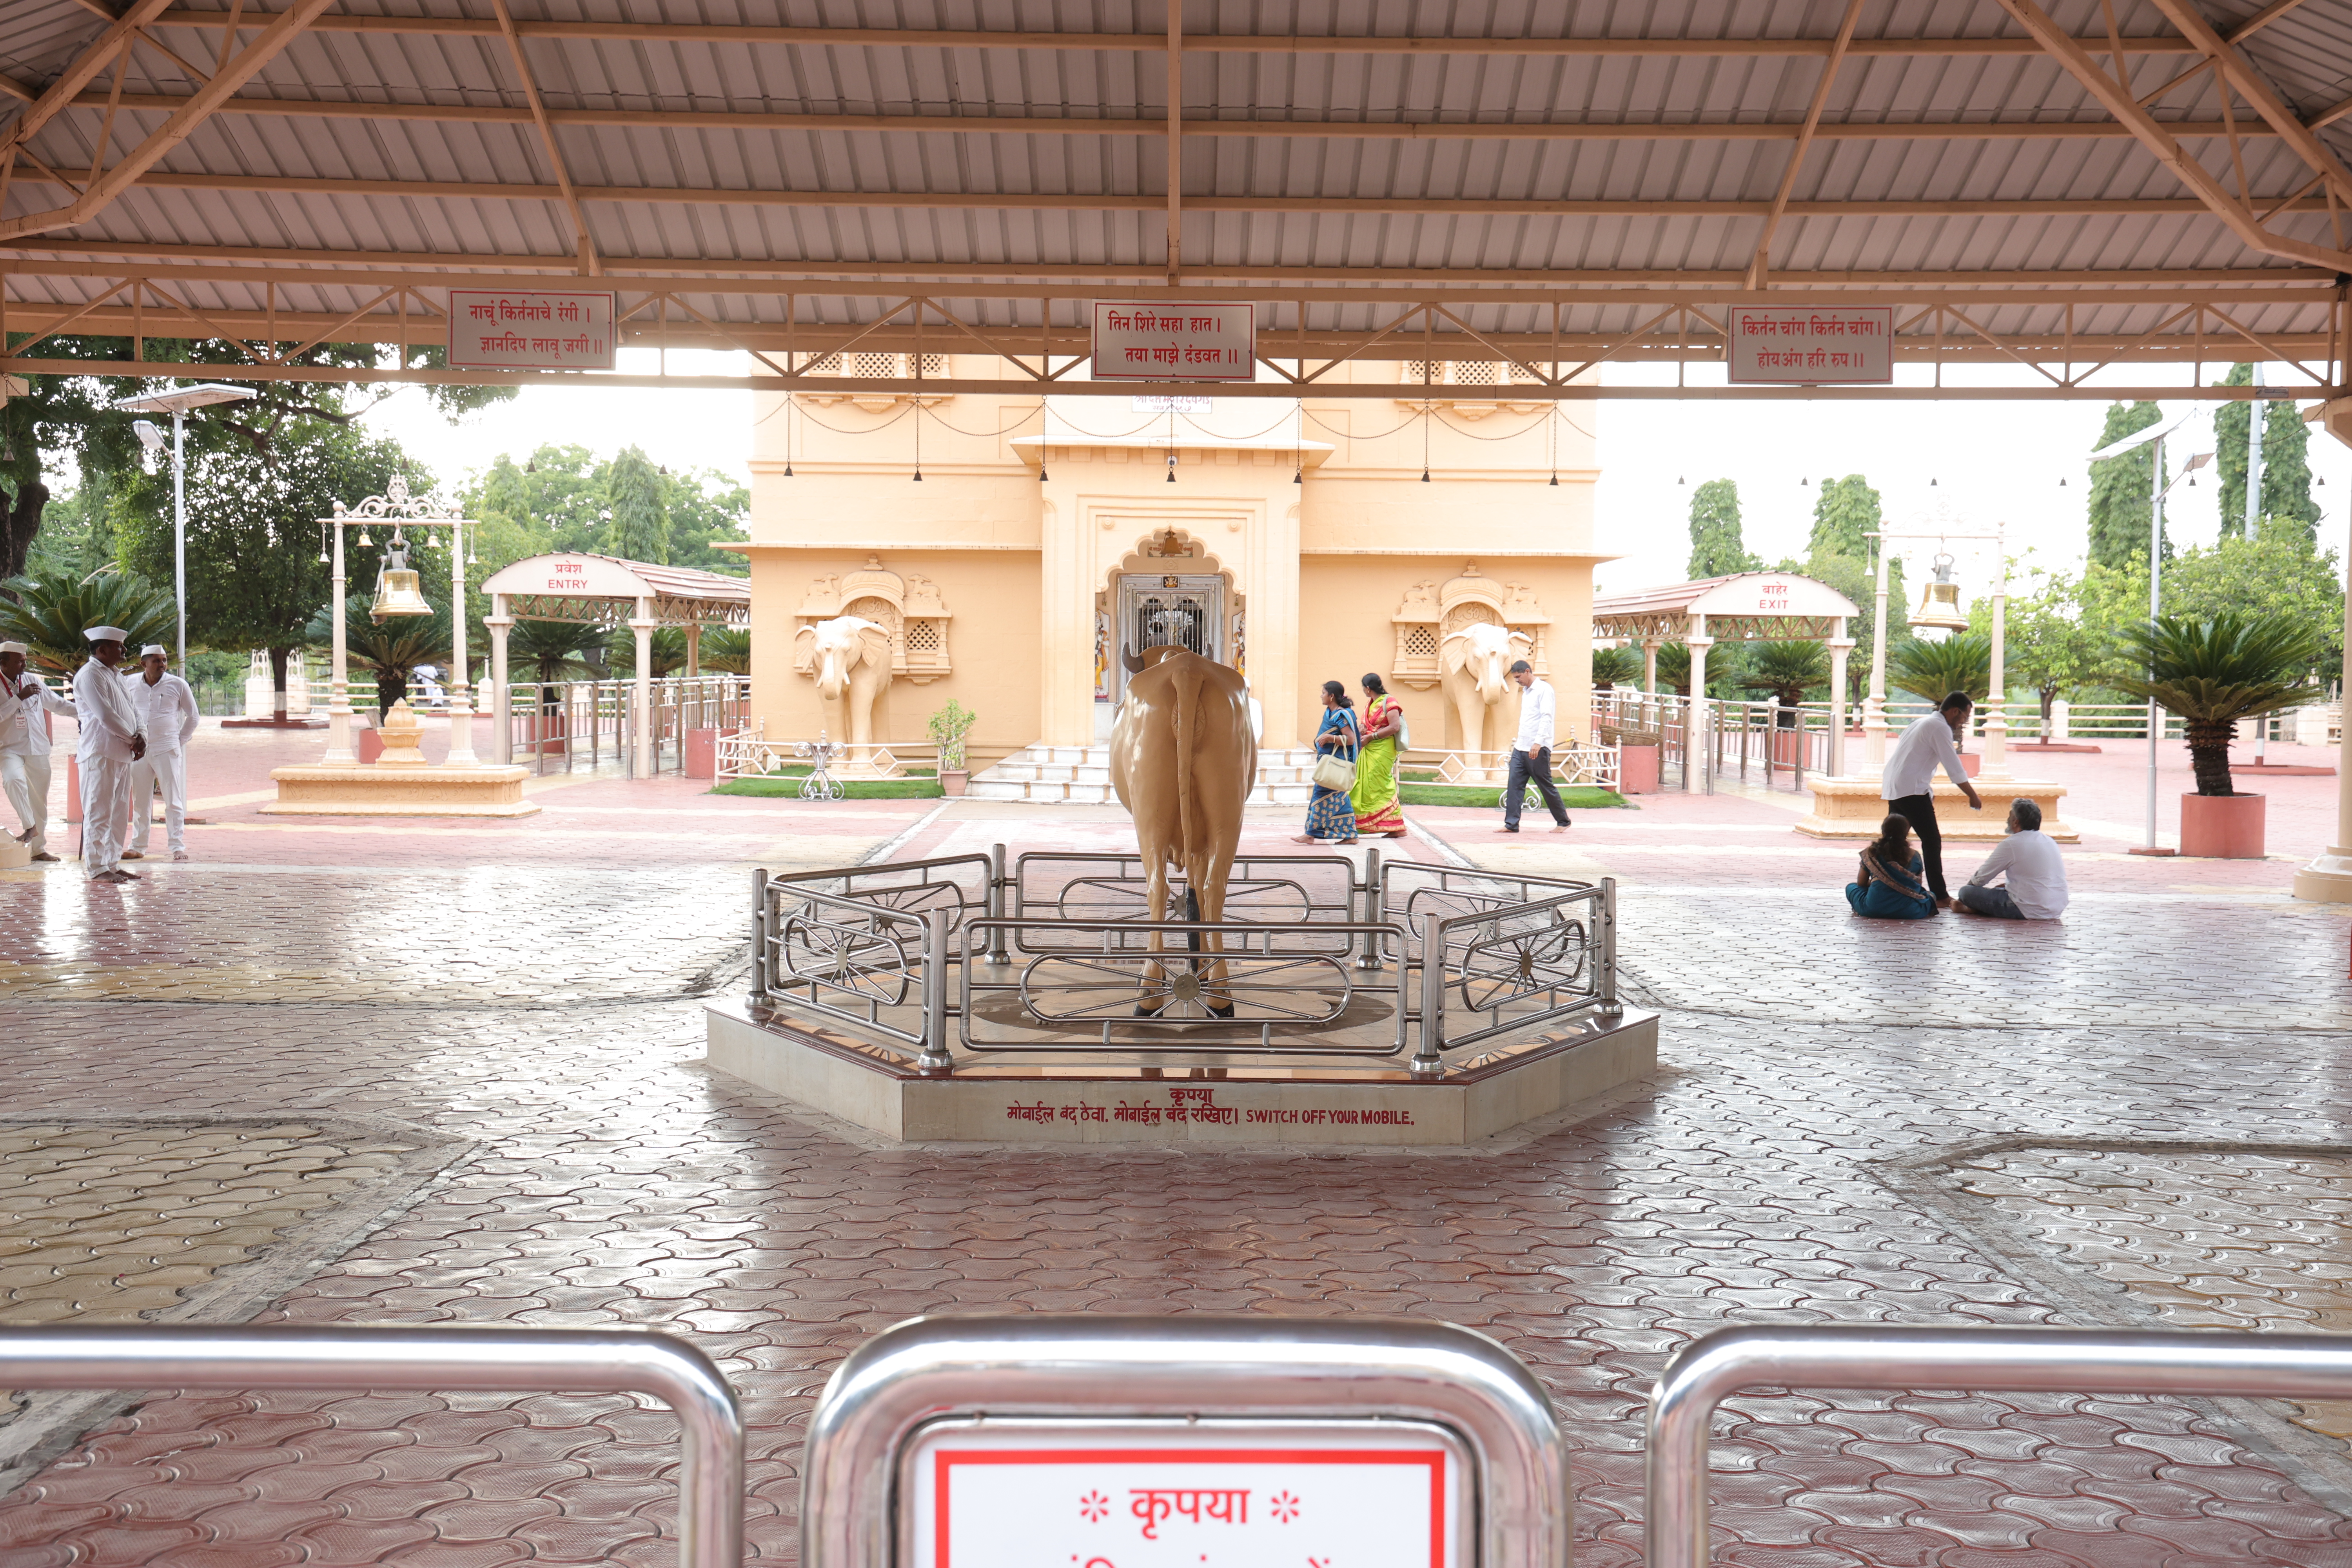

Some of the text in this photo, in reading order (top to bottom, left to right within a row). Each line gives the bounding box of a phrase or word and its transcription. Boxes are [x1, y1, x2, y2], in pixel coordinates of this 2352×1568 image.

[499, 299, 552, 320] किर्तनाचे
[557, 302, 579, 321] रंगी
[1107, 310, 1131, 330] तिन
[1133, 310, 1157, 333] शिरे
[1159, 317, 1184, 333] सहा
[1189, 317, 1213, 333] हात
[1741, 314, 1777, 336] किर्तन
[1779, 317, 1806, 335] चांग
[1809, 315, 1846, 335] किर्तन
[480, 331, 527, 353] ज्ञानदिप
[563, 333, 590, 352] जगी
[1124, 348, 1149, 362] तया
[1152, 342, 1180, 367] माझे
[1184, 344, 1221, 364] दंडवत
[1807, 347, 1826, 369] हरि
[555, 561, 582, 573] प्रवेश
[549, 579, 588, 588] ENTRY
[1763, 582, 1787, 594] बाहेर
[1760, 600, 1788, 608] EXIT
[1169, 1088, 1214, 1106] कृपया
[1007, 1100, 1055, 1124] मोबाईल
[1060, 1105, 1079, 1125] बंद
[1114, 1100, 1163, 1125] मोबाईल
[1164, 1102, 1189, 1123] बंद
[1247, 1109, 1298, 1123] SWITCH
[1302, 1110, 1326, 1124] OFF
[1328, 1110, 1359, 1124] YOUR
[1361, 1110, 1415, 1125] MOBILE.
[1131, 1490, 1250, 1539] कृपया
